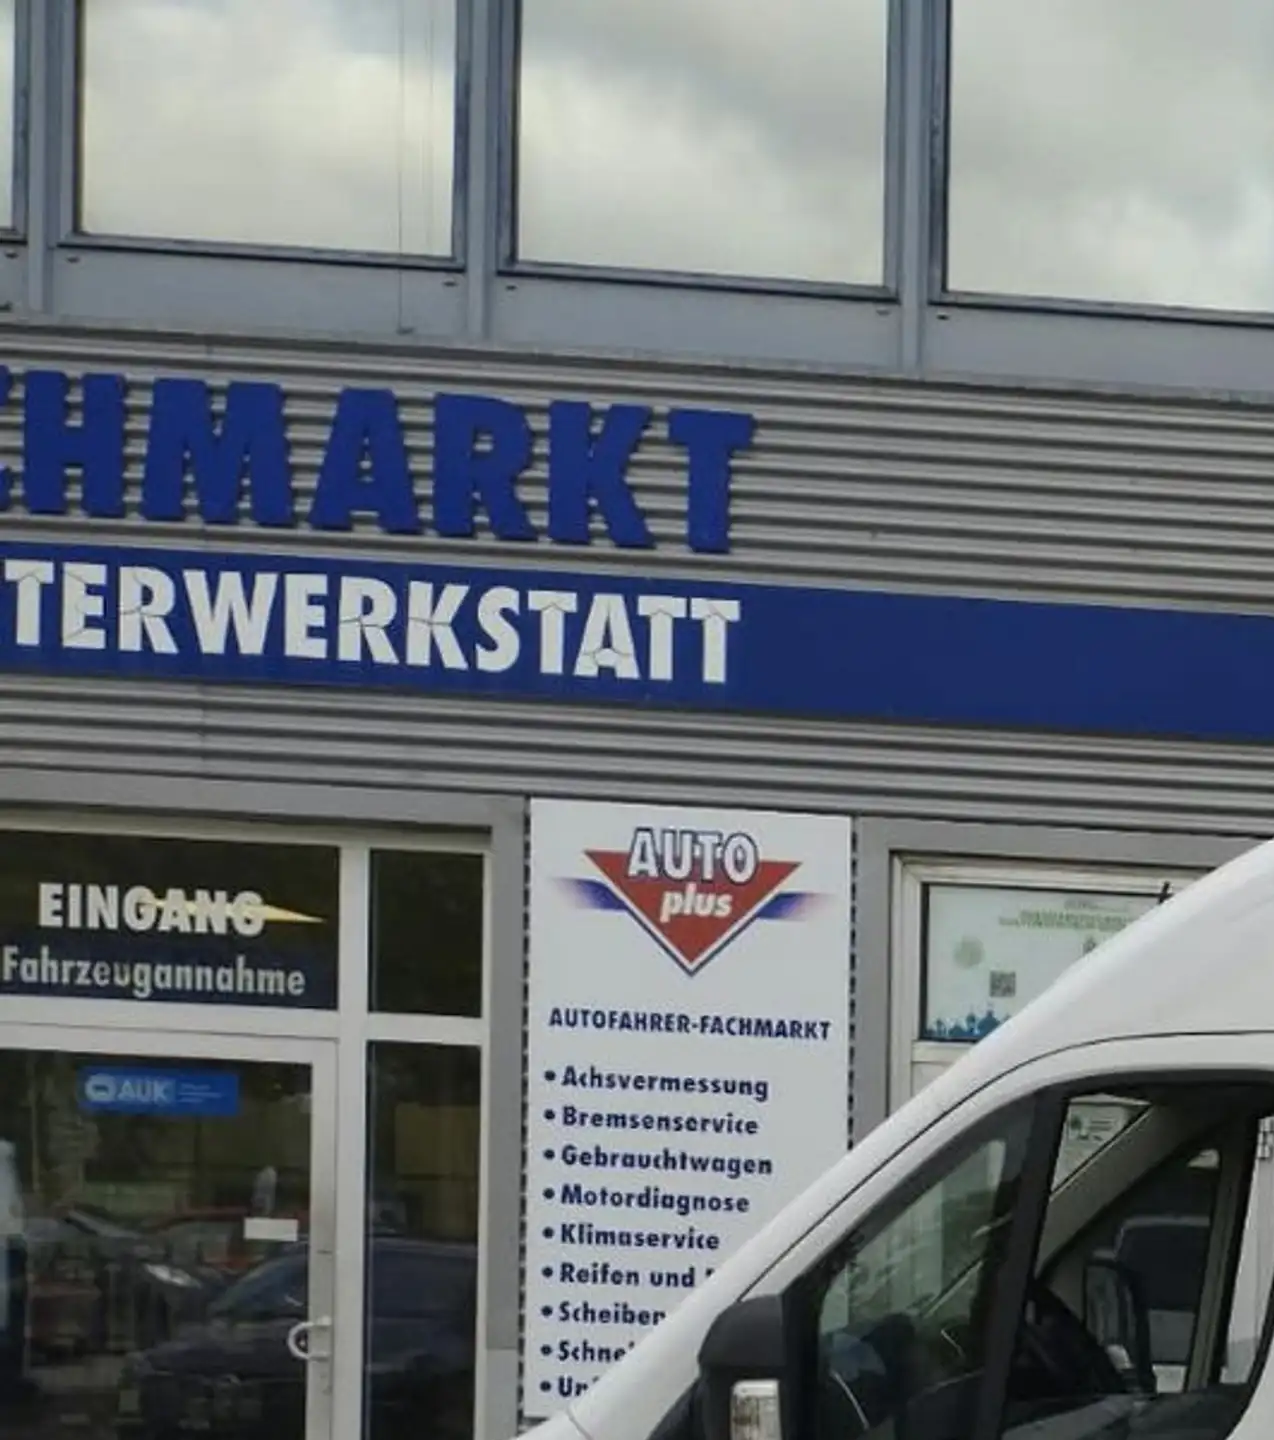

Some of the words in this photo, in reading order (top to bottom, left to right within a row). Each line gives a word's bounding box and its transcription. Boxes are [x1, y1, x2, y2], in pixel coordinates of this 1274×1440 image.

[0, 365, 756, 554] HMARKT
[4, 557, 741, 683] TERWERKSTATT
[627, 827, 759, 885] AUTO
[39, 882, 266, 936] EINGANG
[659, 884, 734, 924] plus
[2, 945, 306, 998] Fahrzeugannahme
[549, 1008, 832, 1040] AUTOFAHRER-FACHMARKT
[561, 1065, 770, 1102] Achsvermessung
[562, 1106, 759, 1135] Bremsenservice
[561, 1145, 773, 1179] Gebrauchtwagen
[561, 1184, 751, 1216] Motordiagnose
[560, 1223, 720, 1250] Klimaservice
[559, 1262, 640, 1286] Reifen
[649, 1266, 696, 1287] und
